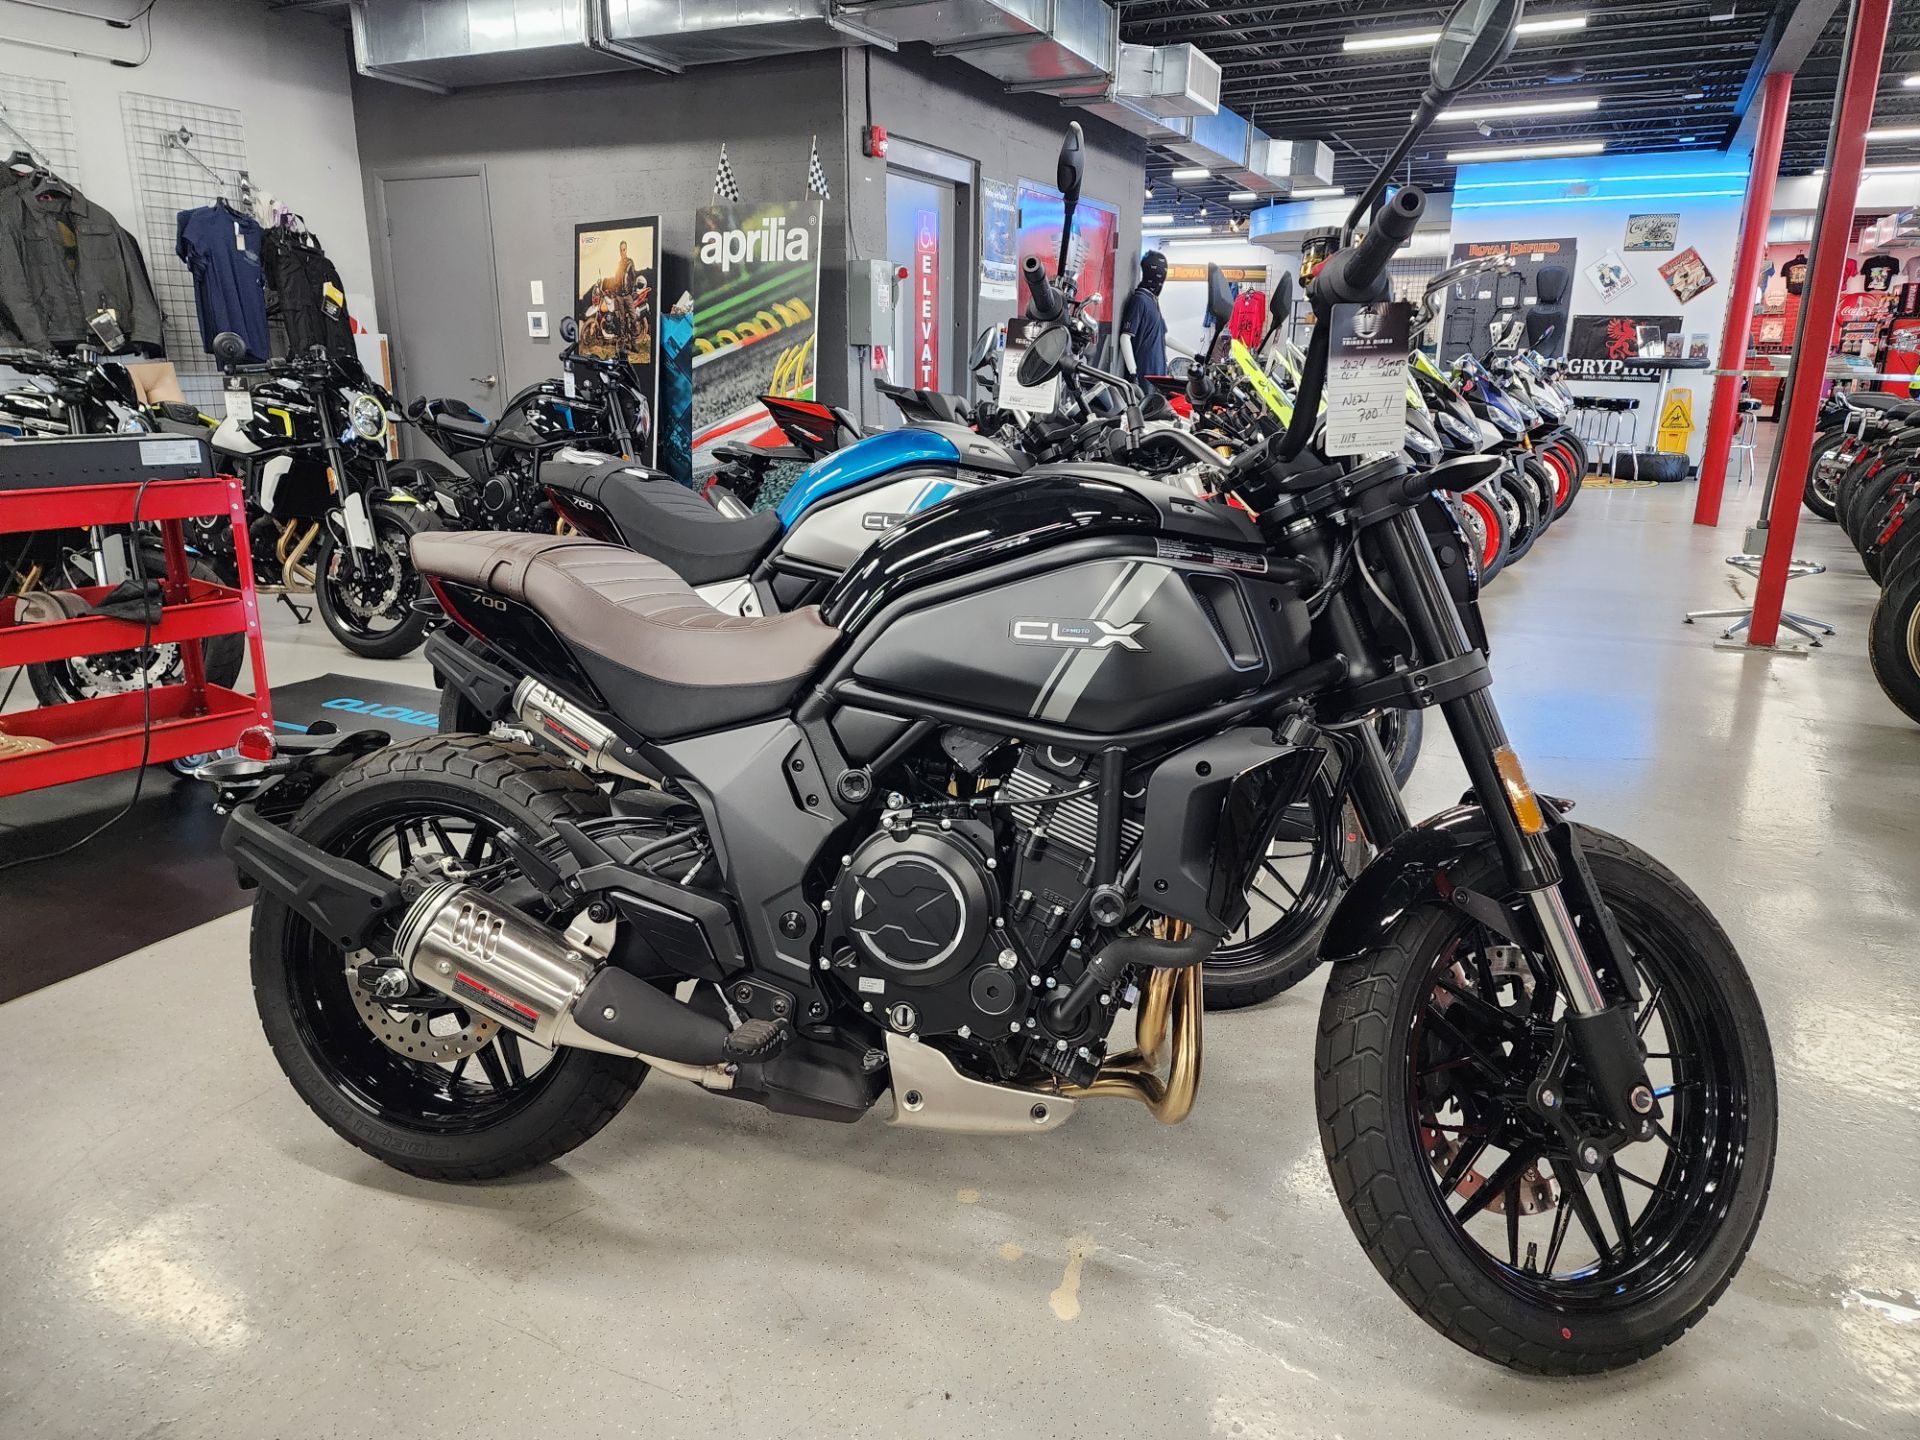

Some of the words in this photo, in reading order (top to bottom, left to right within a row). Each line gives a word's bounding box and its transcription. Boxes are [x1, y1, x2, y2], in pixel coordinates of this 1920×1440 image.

[700, 217, 809, 272] aprilia
[1469, 244, 1507, 257] ROYAL
[1509, 242, 1560, 256] ENFIELD
[921, 255, 932, 392] ELEVAT
[1342, 392, 1370, 406] NEW
[572, 497, 594, 510] 700
[470, 592, 507, 612] 700
